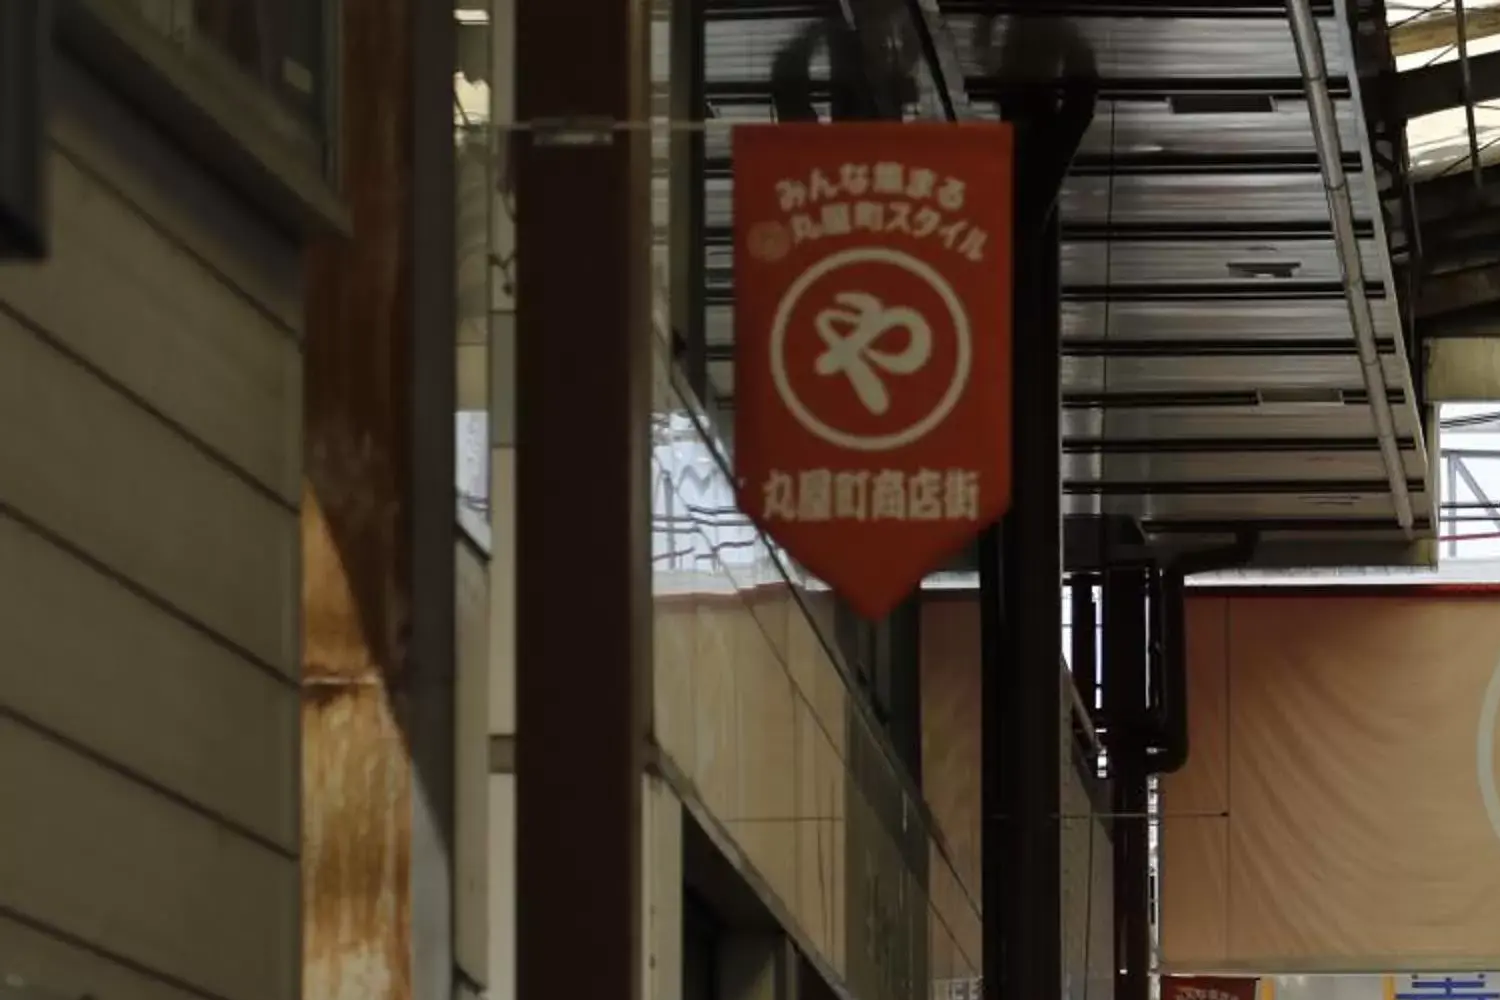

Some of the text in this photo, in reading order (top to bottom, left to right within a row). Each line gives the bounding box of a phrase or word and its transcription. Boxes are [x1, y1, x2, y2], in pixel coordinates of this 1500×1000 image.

[775, 161, 967, 212] みんな集まる
[789, 200, 988, 262] 丸屋町スタイル
[763, 466, 980, 522] 丸屋町商店街
